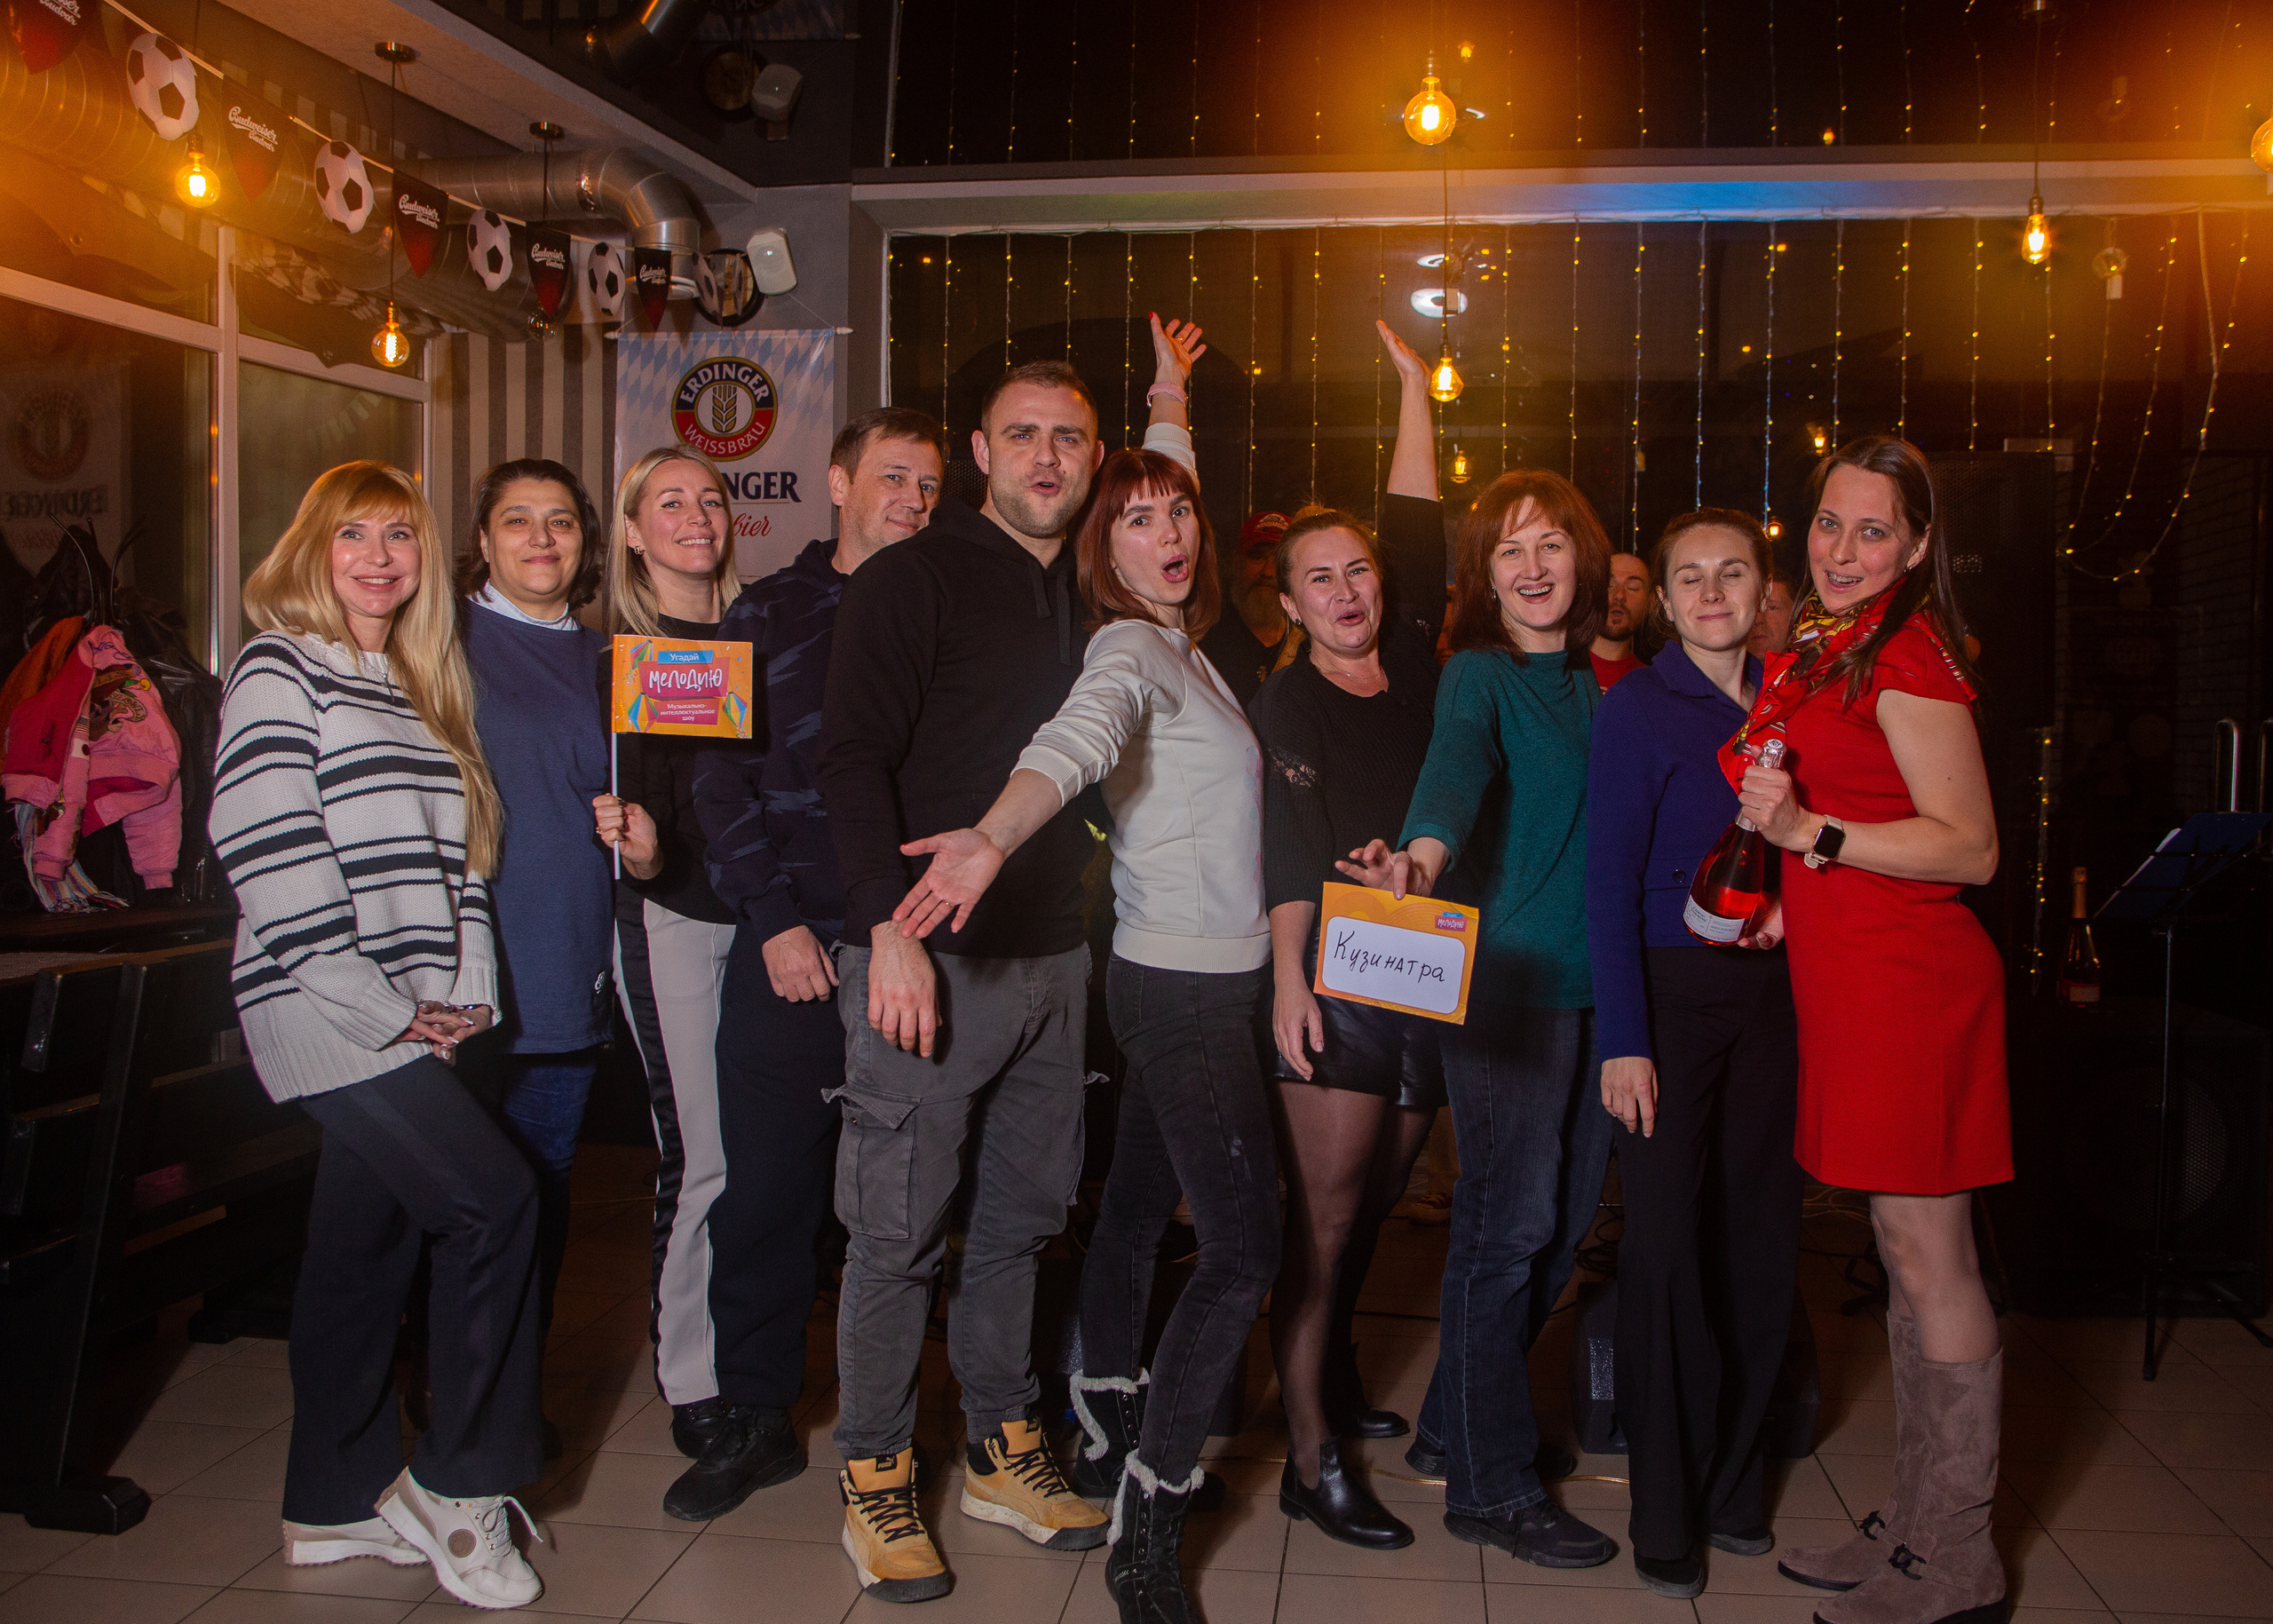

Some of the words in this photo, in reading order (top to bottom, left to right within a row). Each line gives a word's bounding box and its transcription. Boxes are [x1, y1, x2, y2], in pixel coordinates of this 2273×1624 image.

[228, 106, 277, 141] Budweiser
[399, 194, 439, 219] Budweiser
[531, 242, 564, 262] Budweiser
[679, 363, 770, 403] ERDINGER
[685, 422, 765, 454] WEISSBRÄU
[722, 471, 802, 503] NGER
[733, 513, 772, 537] bier
[670, 653, 700, 662] Угадай
[1334, 931, 1445, 983] Кузинатра
